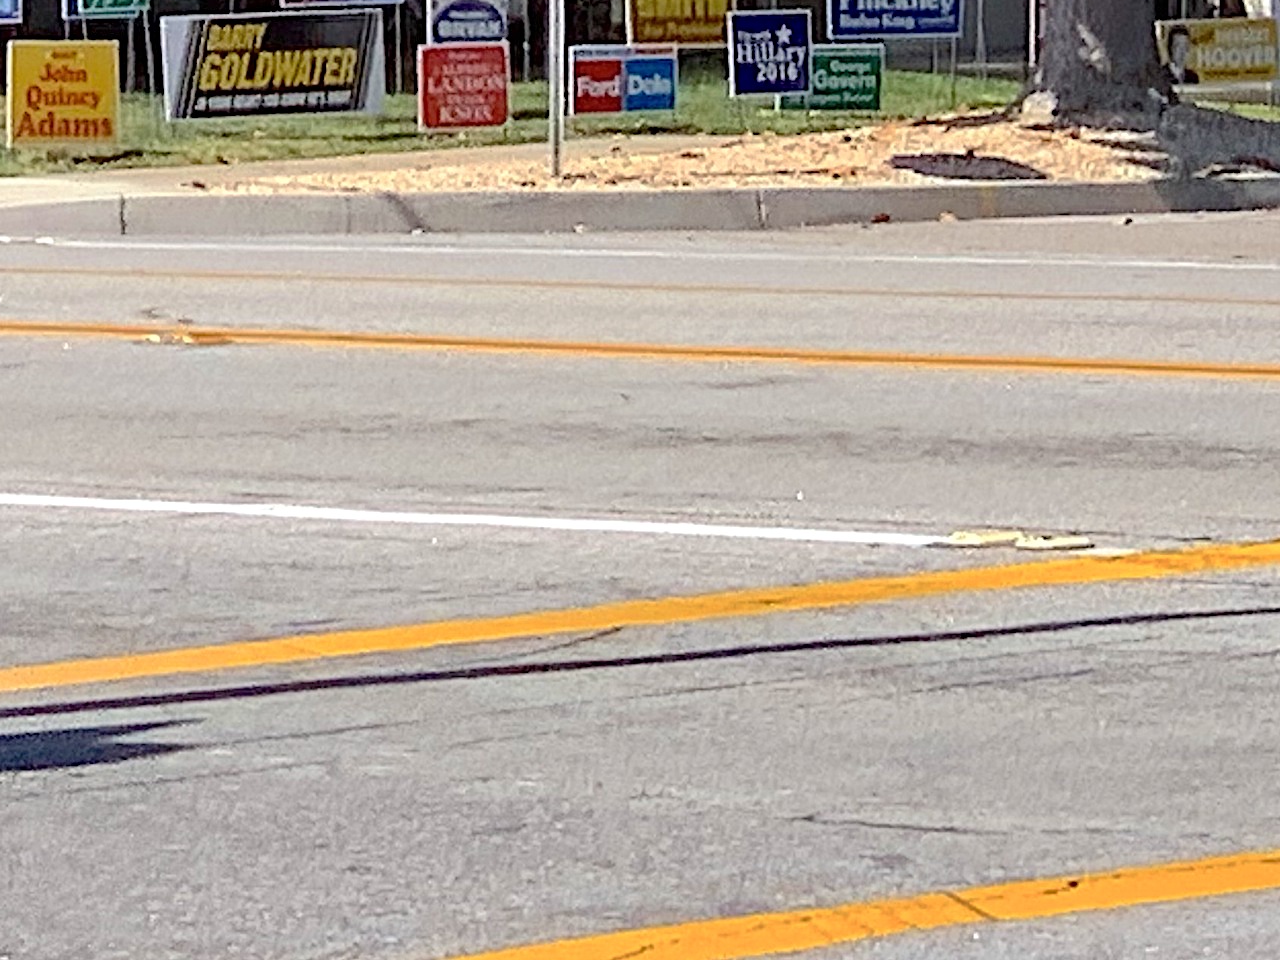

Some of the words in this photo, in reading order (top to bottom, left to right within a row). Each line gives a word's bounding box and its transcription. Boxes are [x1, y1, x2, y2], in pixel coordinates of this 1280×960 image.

[736, 41, 806, 68] Hillary
[39, 63, 88, 82] John
[198, 47, 358, 91] GOLDWATER
[757, 62, 799, 83] 2016
[26, 85, 101, 111] Quincy
[577, 74, 620, 98] Ford
[628, 74, 671, 96] Dole
[15, 111, 114, 137] Adams
